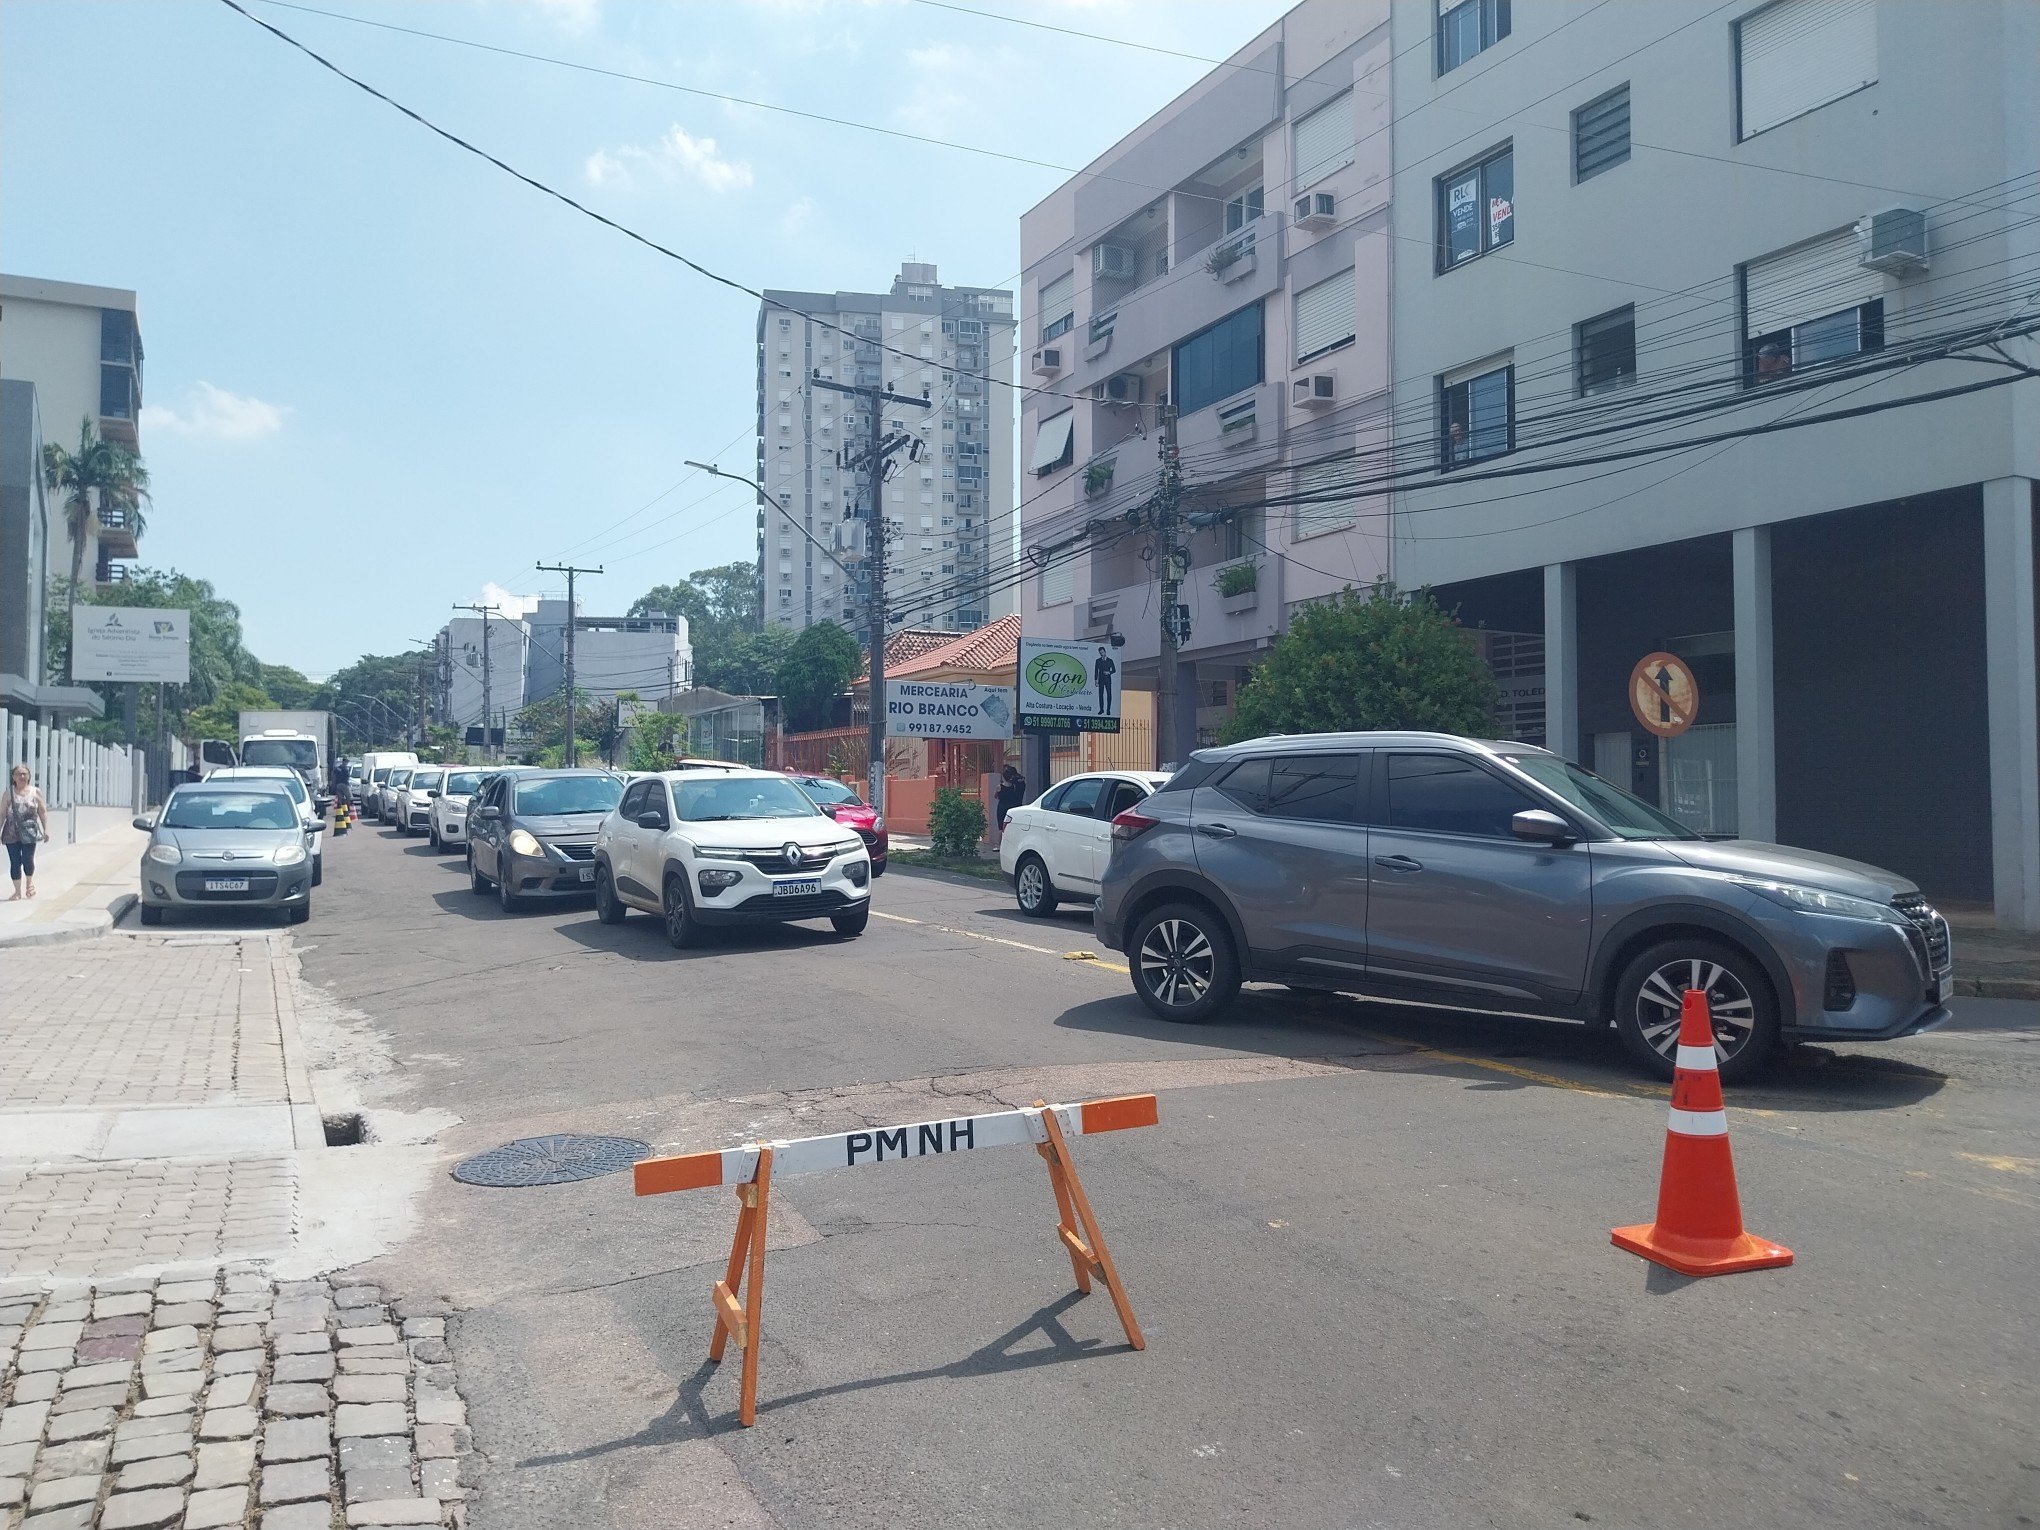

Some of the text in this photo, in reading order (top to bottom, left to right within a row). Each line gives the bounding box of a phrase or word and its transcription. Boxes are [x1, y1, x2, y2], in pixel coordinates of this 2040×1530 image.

[1453, 203, 1473, 217] VENDE
[1034, 657, 1086, 694] Egon
[900, 685, 968, 698] MERCEARIA
[889, 702, 979, 717] RIO BRANCO
[1026, 701, 1034, 709] Alta
[1056, 703, 1074, 711] Locação
[908, 723, 972, 734] 99187.9452
[1033, 717, 1039, 727] 51
[1083, 719, 1090, 729] 51
[777, 883, 816, 896] JBD6A96
